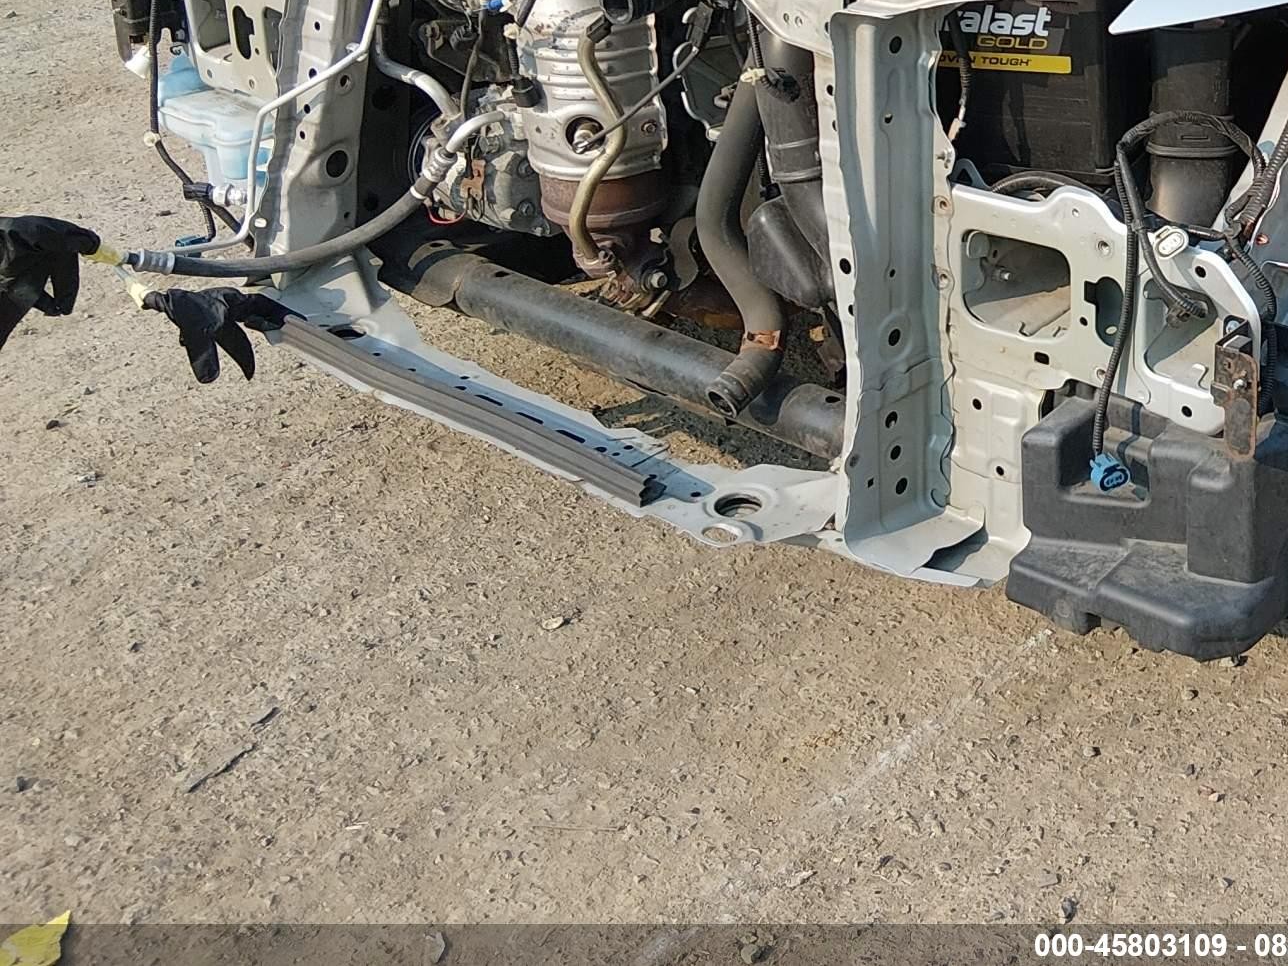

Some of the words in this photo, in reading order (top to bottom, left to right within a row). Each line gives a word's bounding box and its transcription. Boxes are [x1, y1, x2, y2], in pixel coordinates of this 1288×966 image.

[957, 4, 1052, 36] alast
[977, 35, 1048, 50] GOLD
[981, 56, 1030, 67] TOUGH
